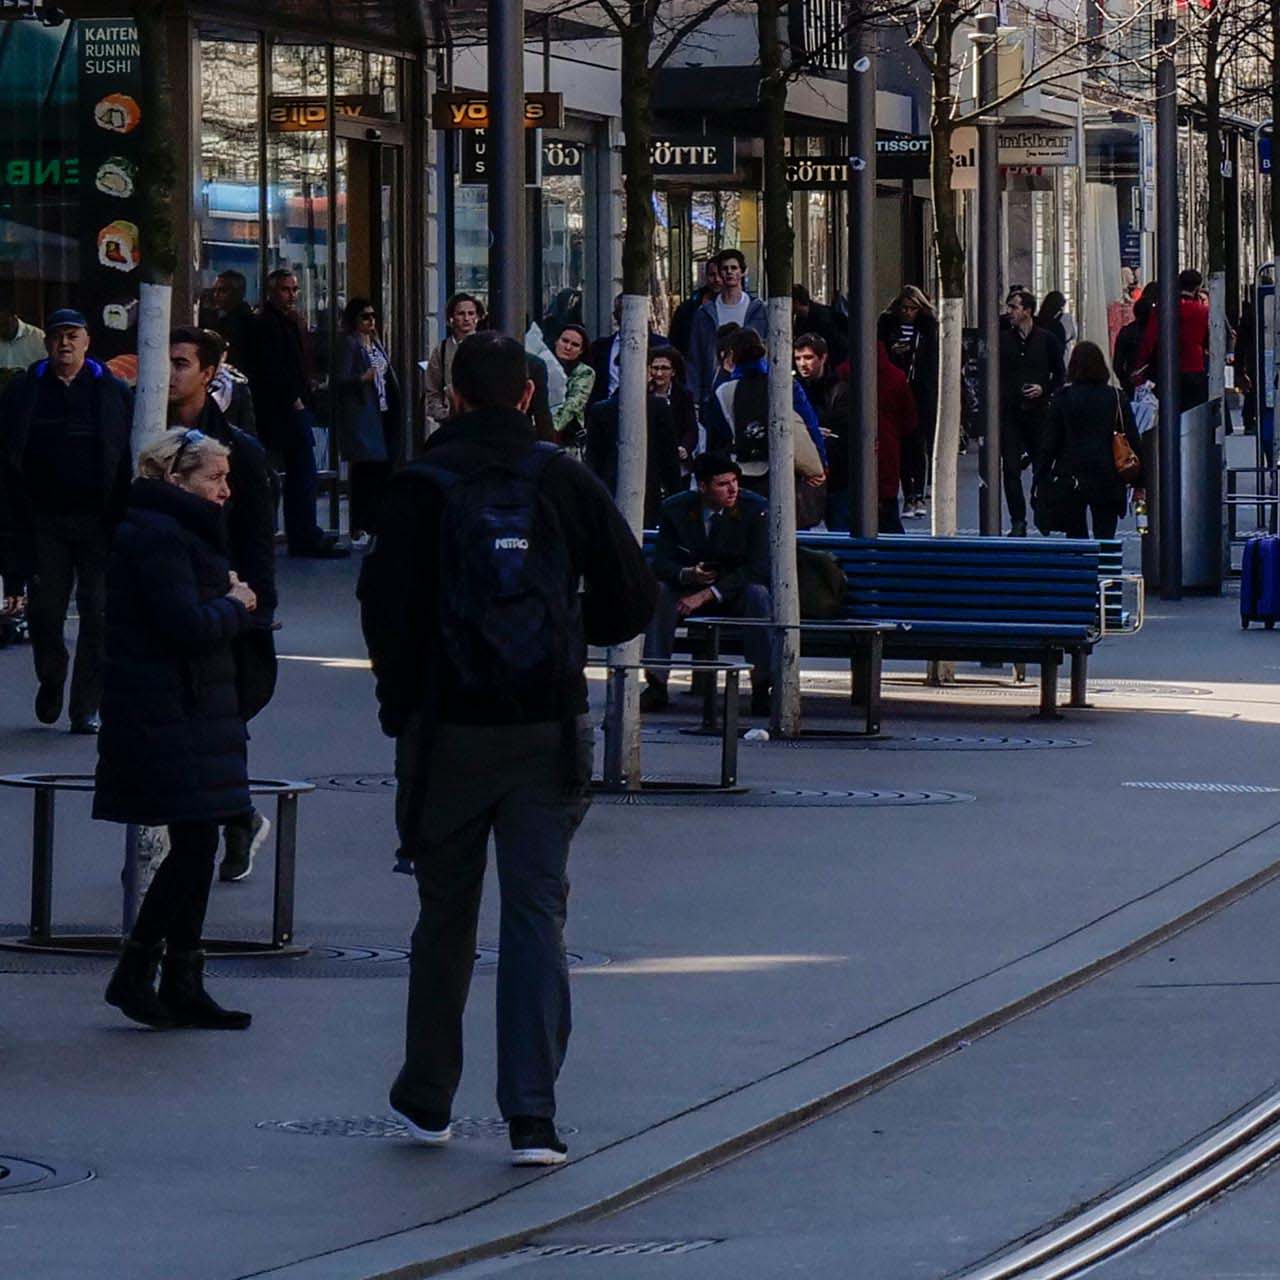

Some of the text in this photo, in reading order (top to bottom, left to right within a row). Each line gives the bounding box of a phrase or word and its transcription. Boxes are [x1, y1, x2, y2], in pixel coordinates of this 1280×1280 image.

[85, 27, 139, 41] KAITEN
[85, 43, 141, 57] RUNNIN
[85, 60, 131, 74] SUSHI
[876, 139, 929, 152] TISSOT
[650, 142, 717, 165] ÖTTE
[495, 538, 529, 549] NITRO
